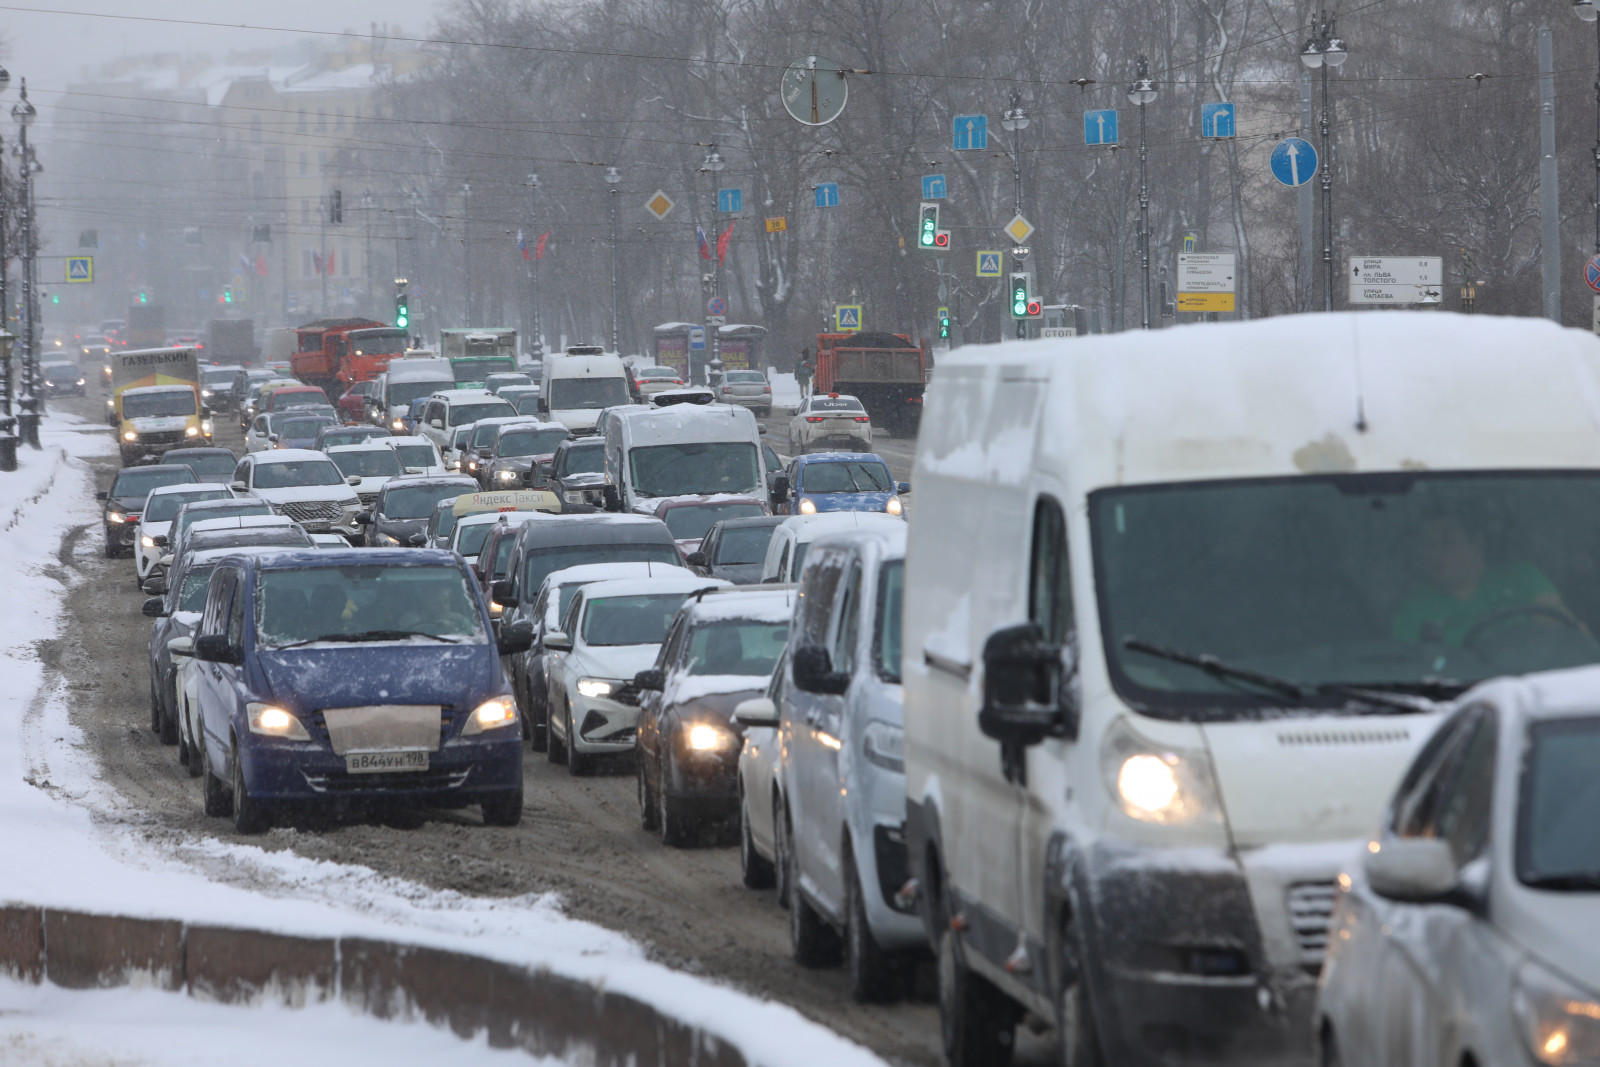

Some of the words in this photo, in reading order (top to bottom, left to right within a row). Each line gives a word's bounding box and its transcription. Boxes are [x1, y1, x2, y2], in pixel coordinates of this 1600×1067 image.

[1045, 330, 1072, 338] СТОП
[122, 352, 188, 366] ГАЗЕЛЬКИН
[661, 350, 684, 359] SALE
[721, 352, 746, 361] SALE
[472, 494, 511, 506] Яндекс
[513, 493, 544, 504] Такси
